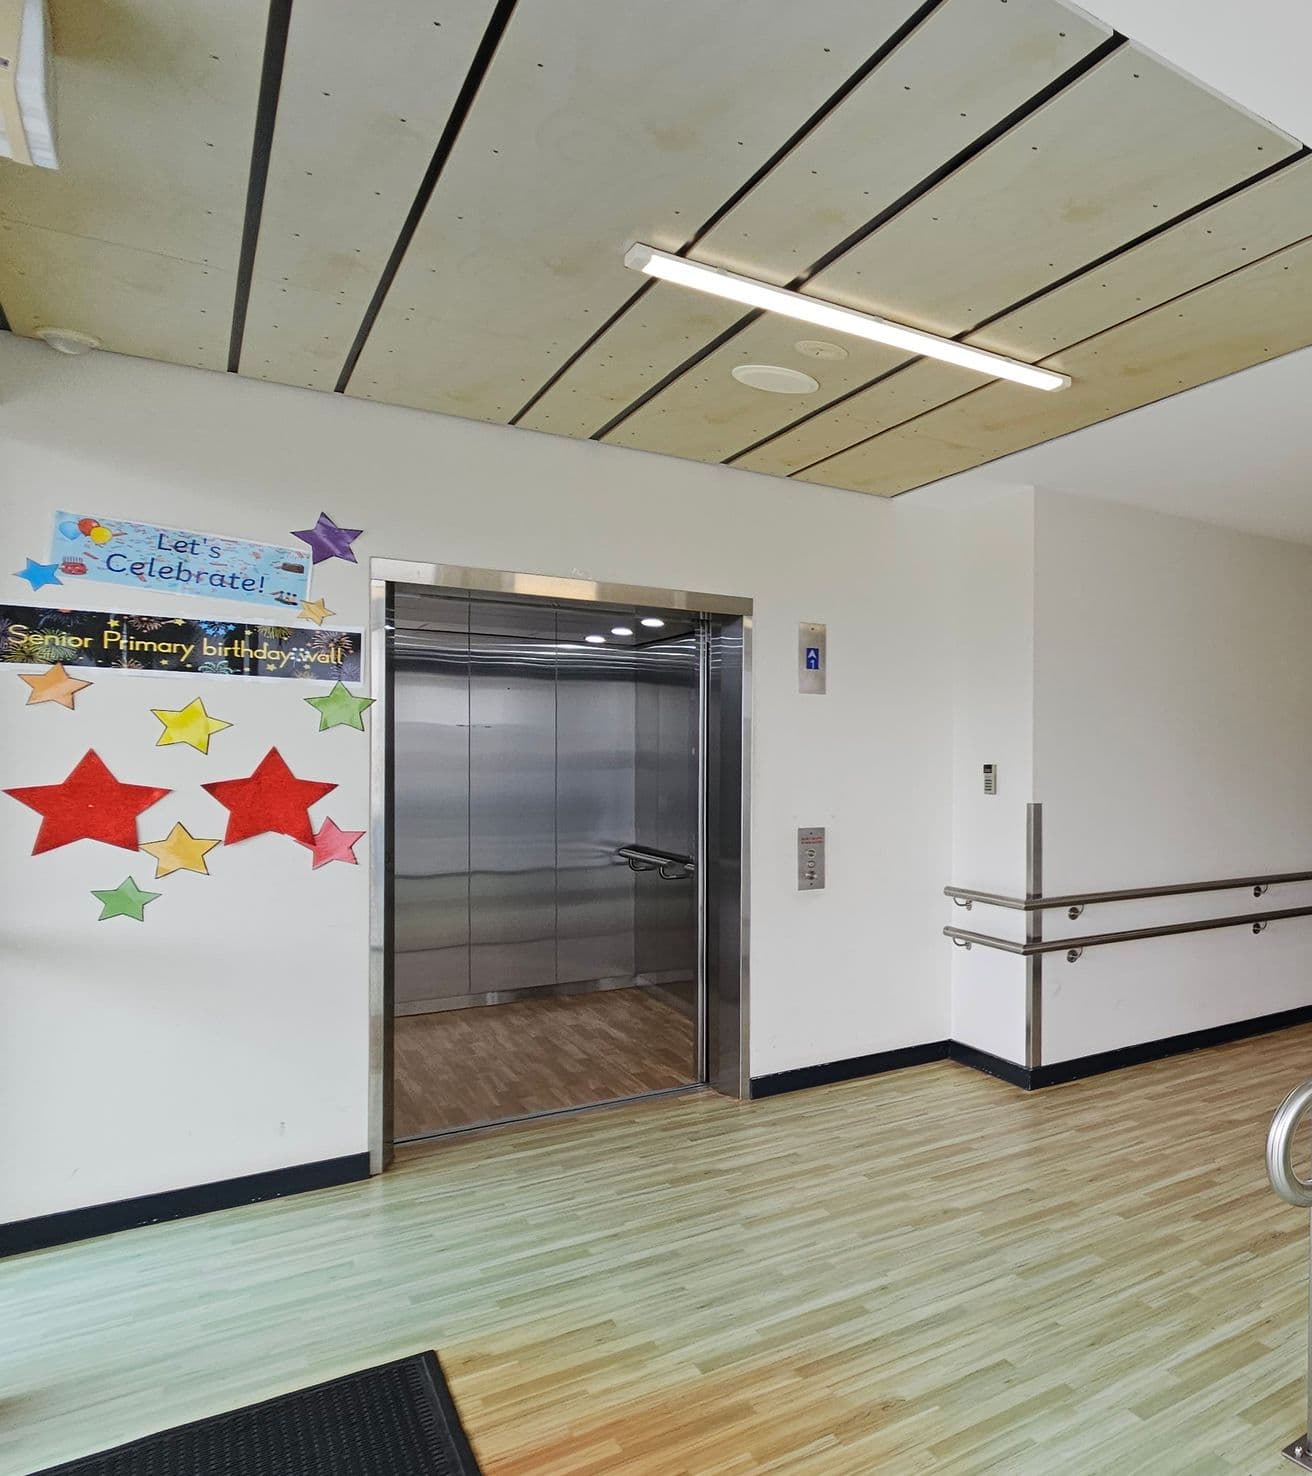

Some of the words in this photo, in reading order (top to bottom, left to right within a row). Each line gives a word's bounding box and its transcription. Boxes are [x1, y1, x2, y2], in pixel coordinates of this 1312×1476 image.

[157, 532, 221, 559] Let's
[105, 553, 265, 593] Celebrate!
[7, 624, 94, 648] Senior
[103, 630, 195, 662] Primary
[203, 637, 290, 668] birthday
[301, 648, 343, 664] wall
[810, 659, 815, 669] 1
